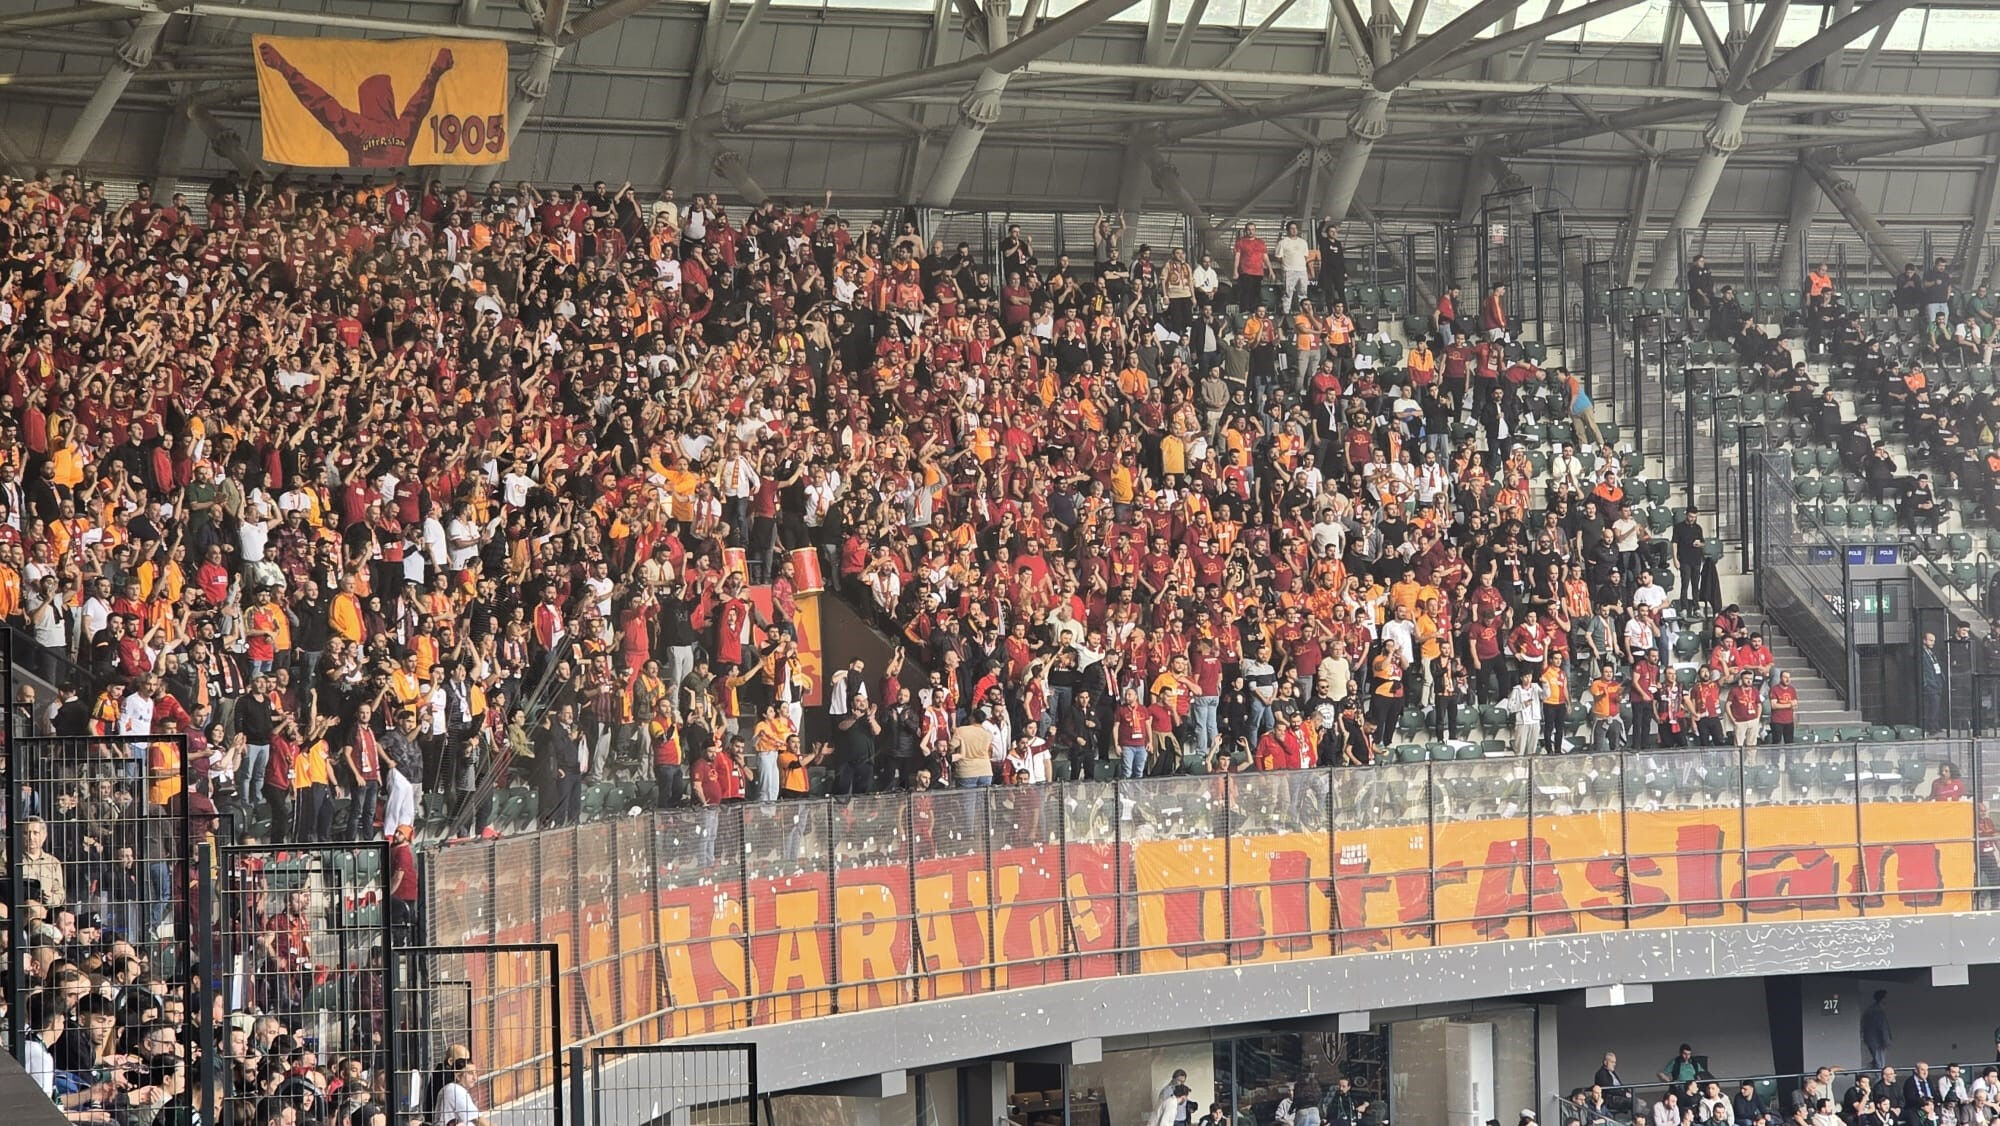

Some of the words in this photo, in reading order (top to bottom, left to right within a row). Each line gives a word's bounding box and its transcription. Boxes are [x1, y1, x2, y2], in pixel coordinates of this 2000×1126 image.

[430, 114, 506, 154] 1905
[1164, 824, 1944, 960] ultrAslan
[1824, 1000, 1839, 1009] 217
